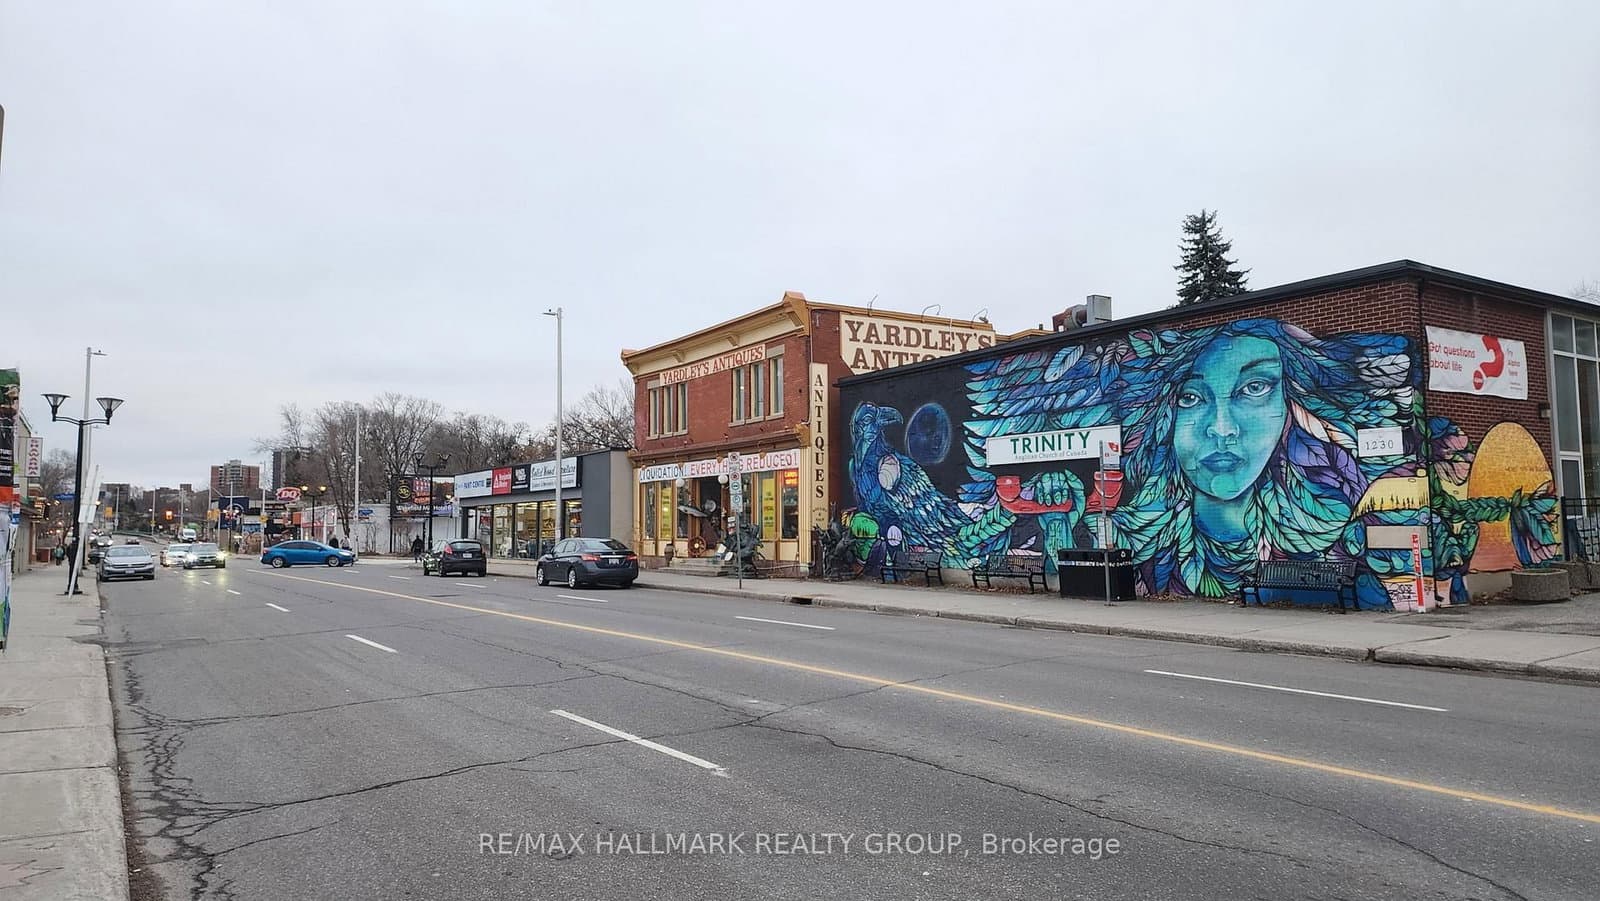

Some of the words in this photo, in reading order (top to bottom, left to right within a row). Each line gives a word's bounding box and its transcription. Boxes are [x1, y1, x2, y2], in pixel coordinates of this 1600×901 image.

[845, 320, 992, 352] YARDLEY'S
[1428, 341, 1442, 352] Got
[1443, 346, 1476, 359] questions
[663, 361, 710, 384] YARDLEY'S
[712, 346, 763, 373] ANTIQUES
[1429, 359, 1451, 370] about
[1451, 361, 1463, 372] life
[814, 374, 825, 498] ANTIQUES
[1010, 431, 1091, 454] TRINITY
[1365, 439, 1394, 450] 1230
[1038, 451, 1058, 459] Church
[1066, 449, 1087, 457] Canada
[639, 465, 688, 481] LIQUIDATION!
[690, 459, 744, 476] EVERYTHG
[747, 453, 798, 470] REDUCED!
[281, 490, 297, 499] DQ
